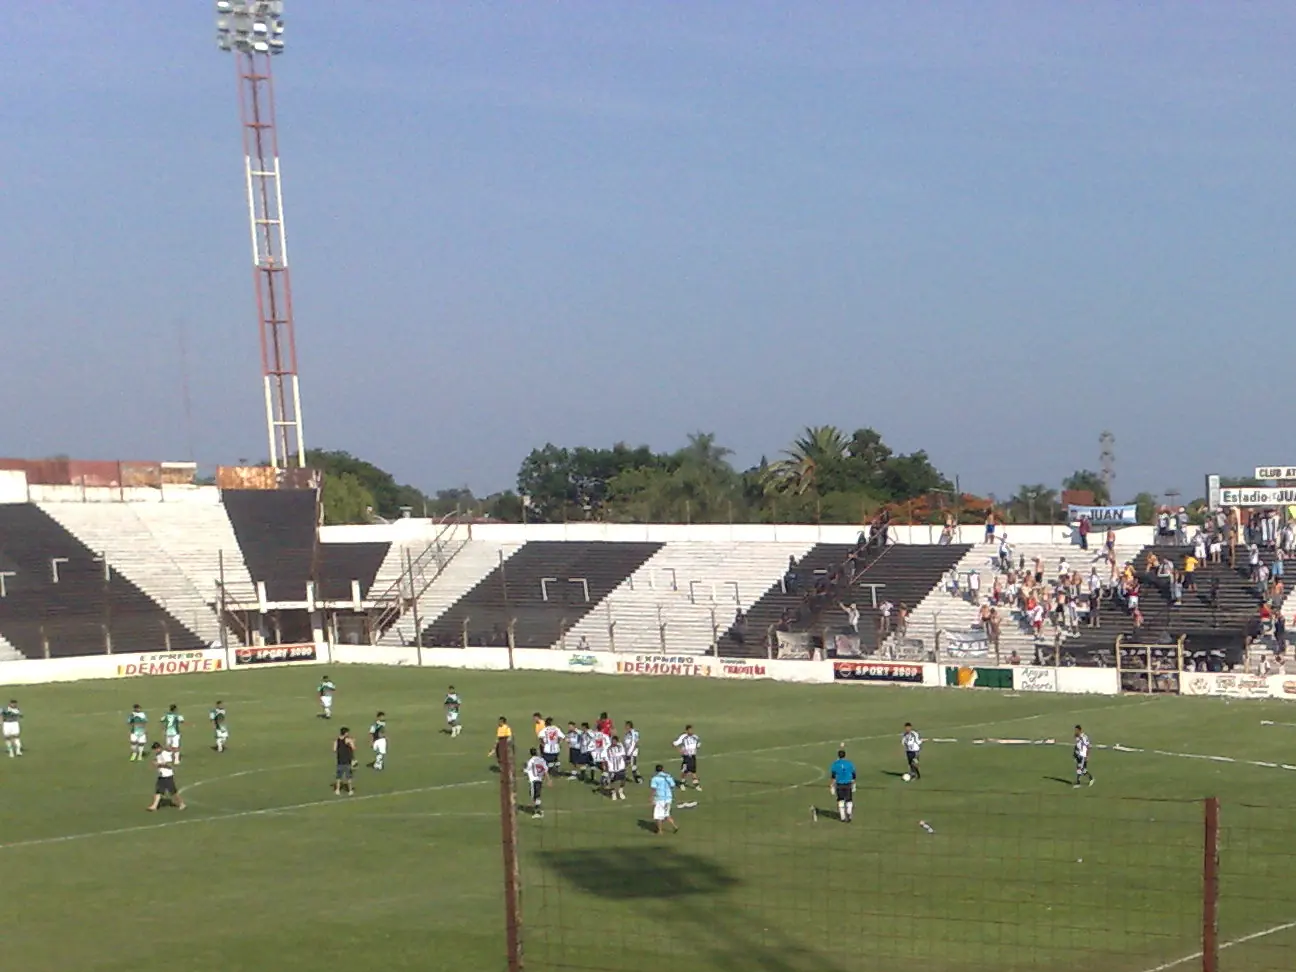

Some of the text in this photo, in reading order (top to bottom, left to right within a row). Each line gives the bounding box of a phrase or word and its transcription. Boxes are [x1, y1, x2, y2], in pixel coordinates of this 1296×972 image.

[1259, 468, 1281, 478] CLUB
[1223, 490, 1267, 503] Estadio
[1088, 508, 1124, 520] JUAN
[125, 658, 213, 675] DEMONTE
[623, 661, 701, 677] DEMONTE
[854, 664, 889, 677] SPORT
